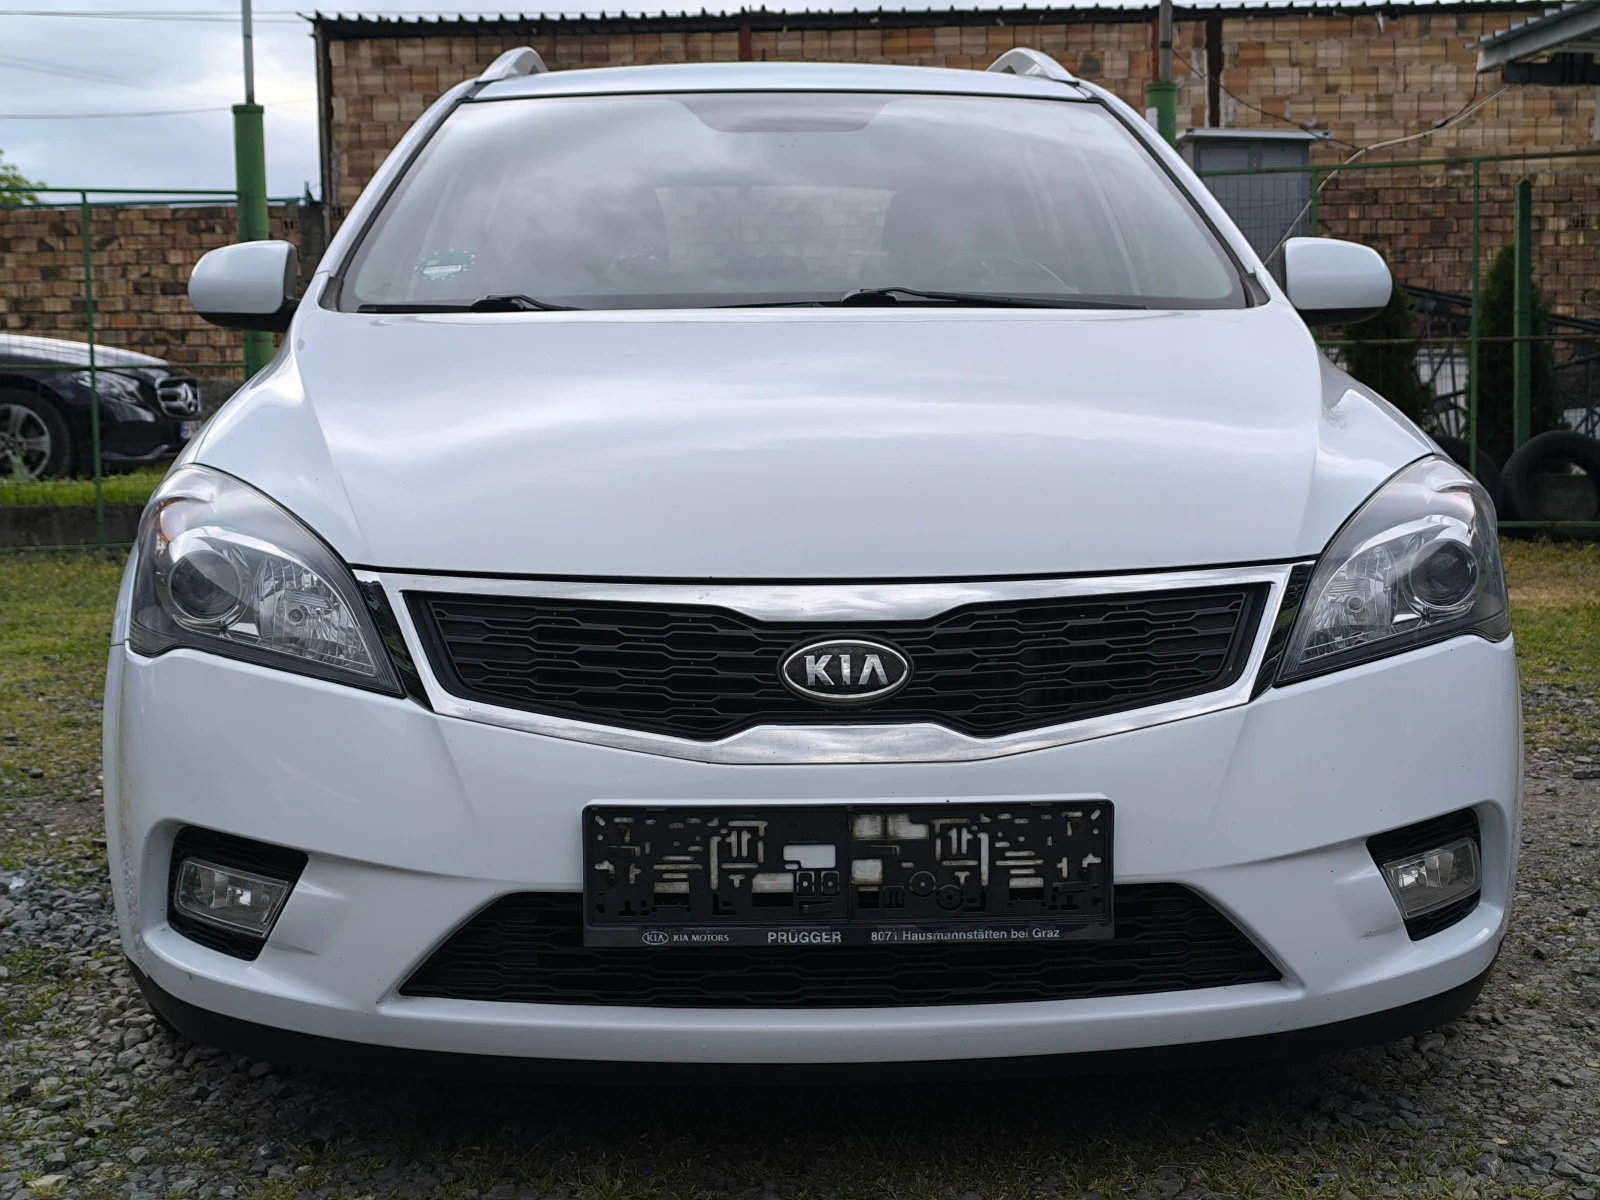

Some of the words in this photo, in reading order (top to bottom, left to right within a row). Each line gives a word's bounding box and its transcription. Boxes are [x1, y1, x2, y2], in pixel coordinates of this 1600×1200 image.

[804, 654, 889, 686] KIA
[673, 932, 689, 942] KIA
[691, 931, 730, 942] MOTORS
[767, 929, 842, 944] PRÜGGER
[870, 931, 898, 941] 8071
[902, 928, 1007, 941] Hausmannstätten
[1010, 928, 1029, 939] bei
[1032, 928, 1060, 939] Graz
